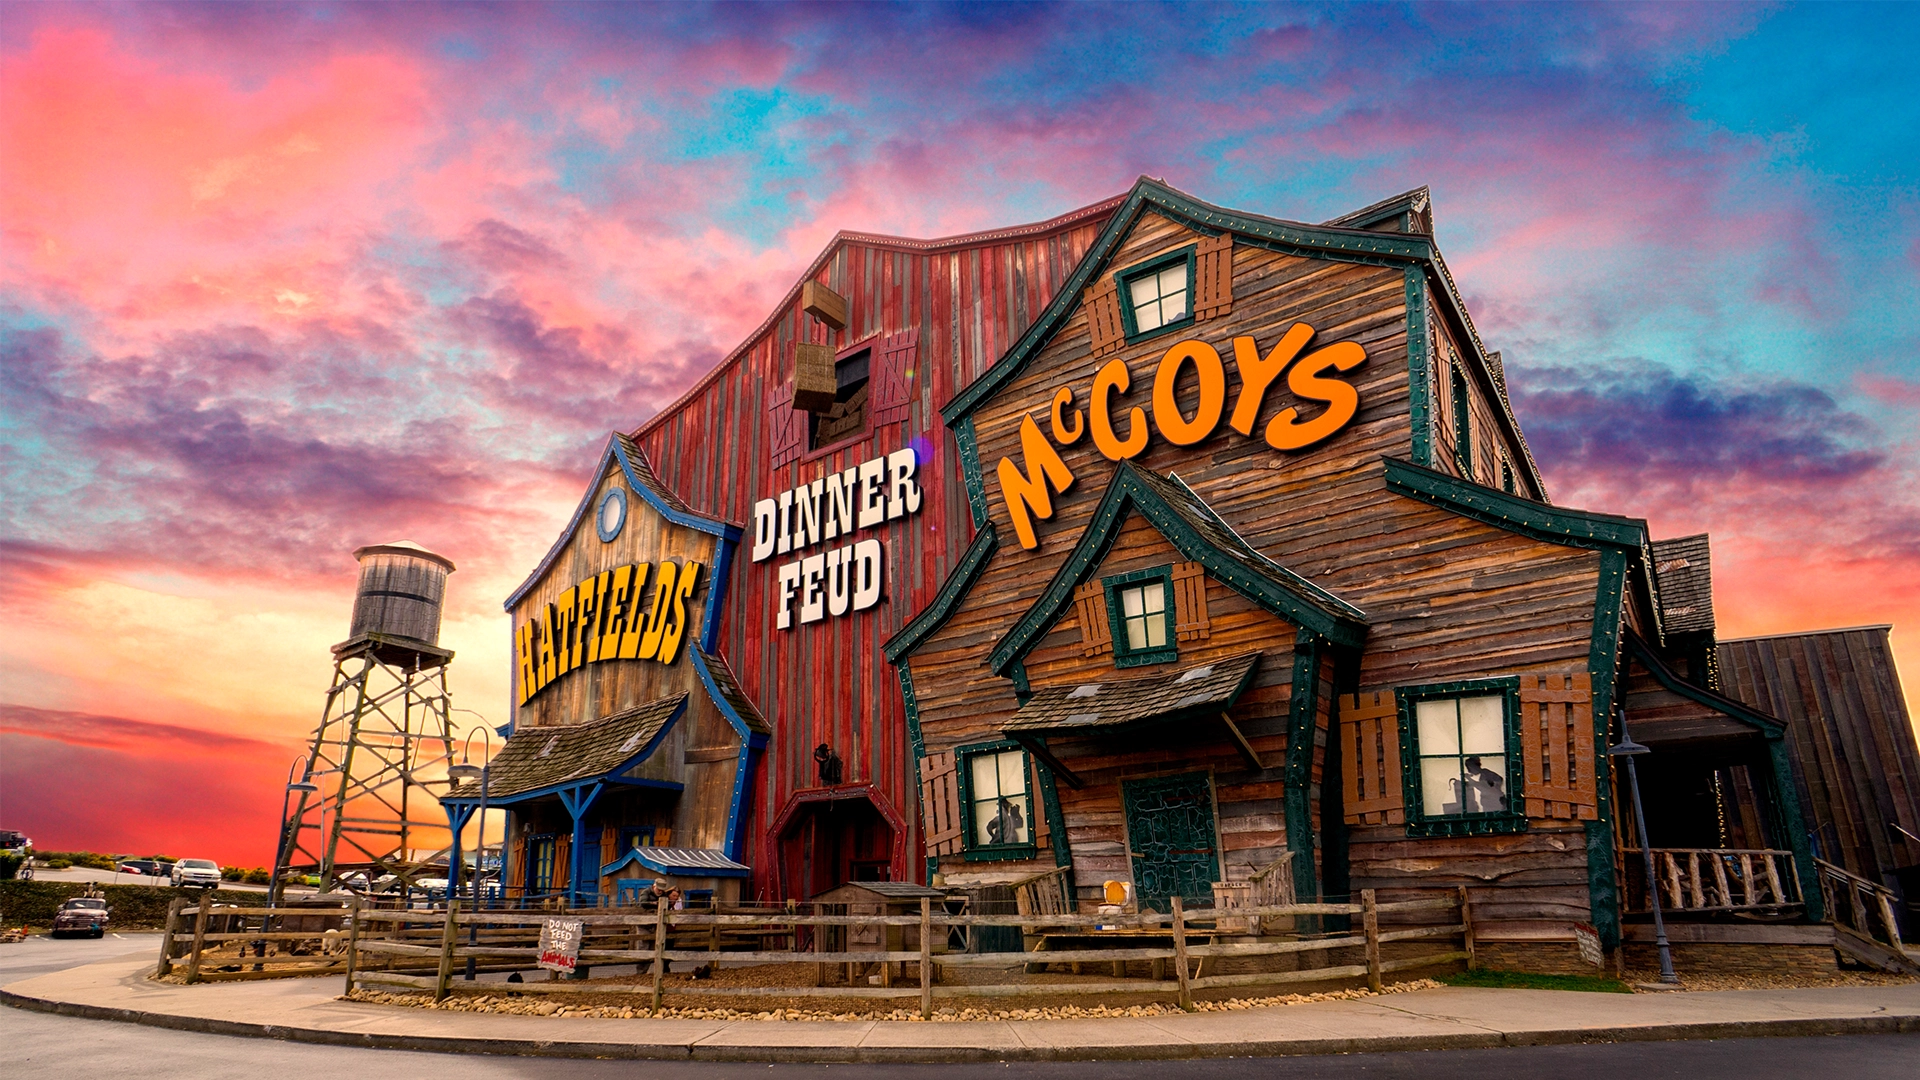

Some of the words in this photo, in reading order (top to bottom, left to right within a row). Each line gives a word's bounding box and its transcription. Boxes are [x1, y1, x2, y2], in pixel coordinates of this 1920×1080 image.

[752, 448, 922, 563] DINNER
[777, 539, 882, 630] FEUD
[516, 561, 699, 706] HATFIELDS
[549, 919, 560, 929] DO
[562, 921, 579, 932] NOT
[551, 929, 572, 940] FEED
[551, 940, 567, 950] THE
